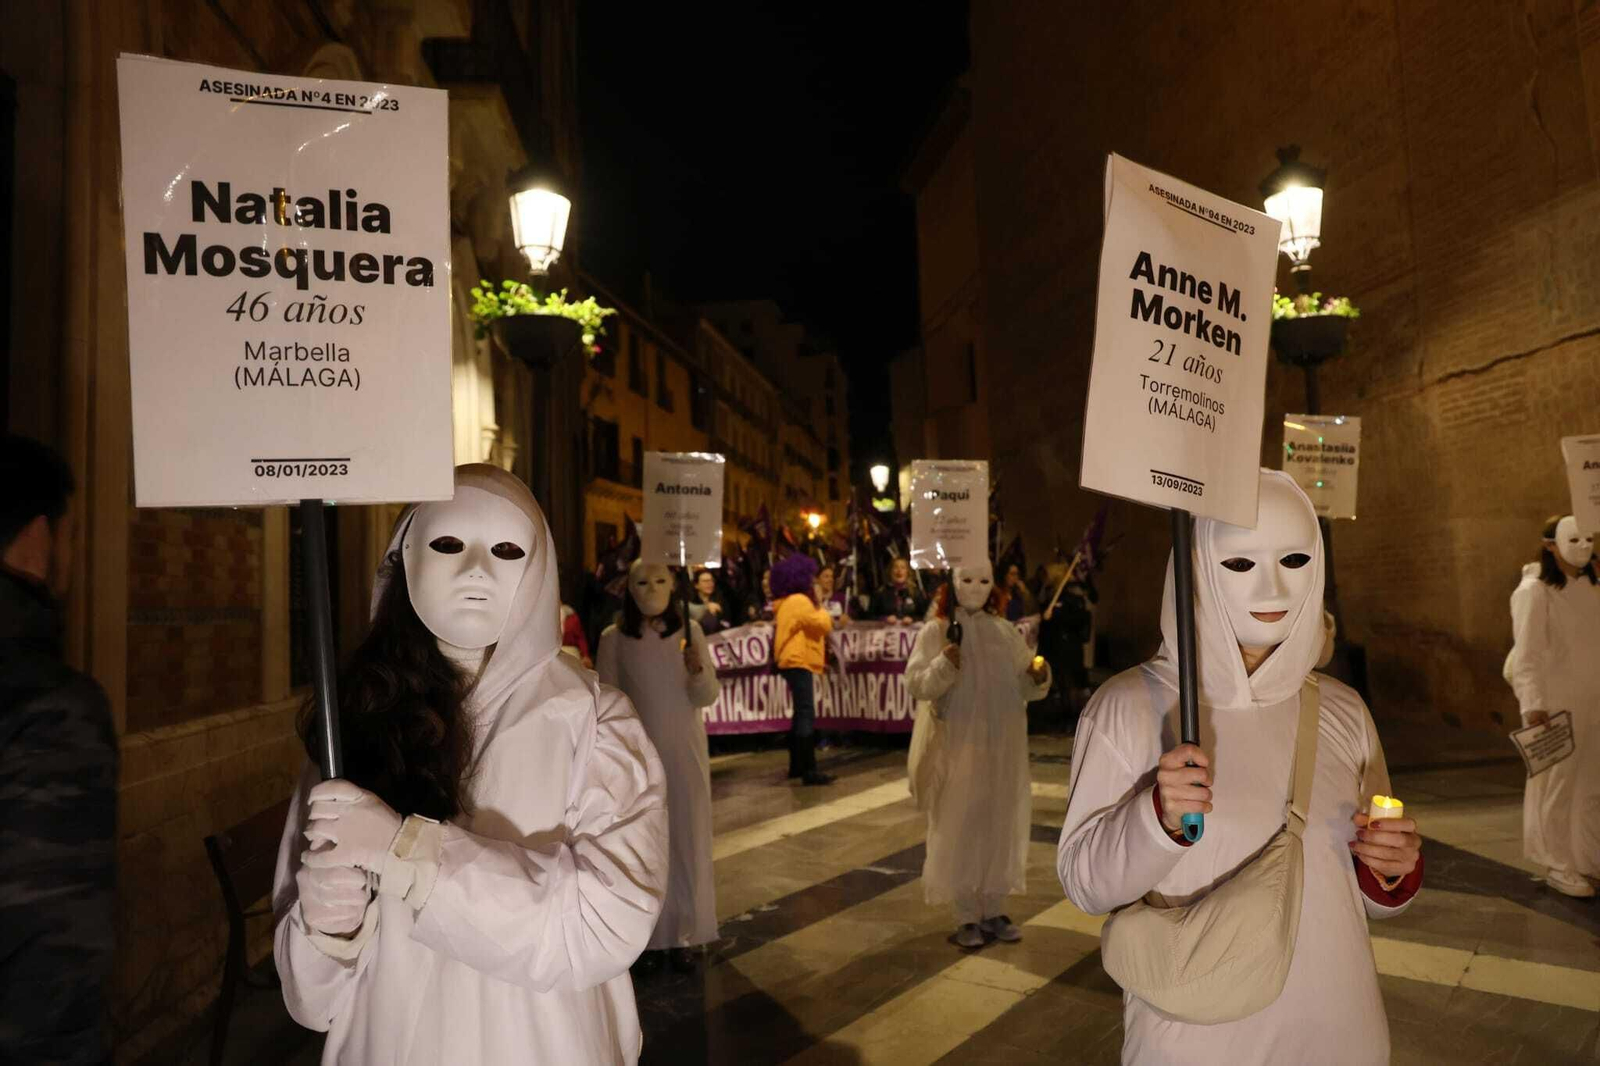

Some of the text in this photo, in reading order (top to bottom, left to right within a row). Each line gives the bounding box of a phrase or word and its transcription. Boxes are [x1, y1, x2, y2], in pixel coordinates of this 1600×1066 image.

[199, 79, 297, 101] ASESINADA
[302, 90, 331, 104] Nº4
[336, 94, 356, 106] EN
[191, 179, 391, 233] Natalia
[1149, 184, 1255, 235] ASESINADA Nº94 EN 2023
[144, 232, 434, 290] Mosquera
[1129, 251, 1247, 321] Anne M.
[226, 291, 366, 326] 46 años
[1131, 288, 1242, 356] Morken
[244, 341, 350, 362] Marbella
[1148, 340, 1223, 384] 21 años
[234, 361, 360, 391] (MÁLAGA)
[1140, 374, 1225, 415] Torremolinos
[1148, 398, 1216, 432] (MÁLAGA)
[254, 463, 348, 478] 08/01/2023
[1151, 474, 1203, 497] 13/09/2023
[655, 482, 712, 495] Antonia
